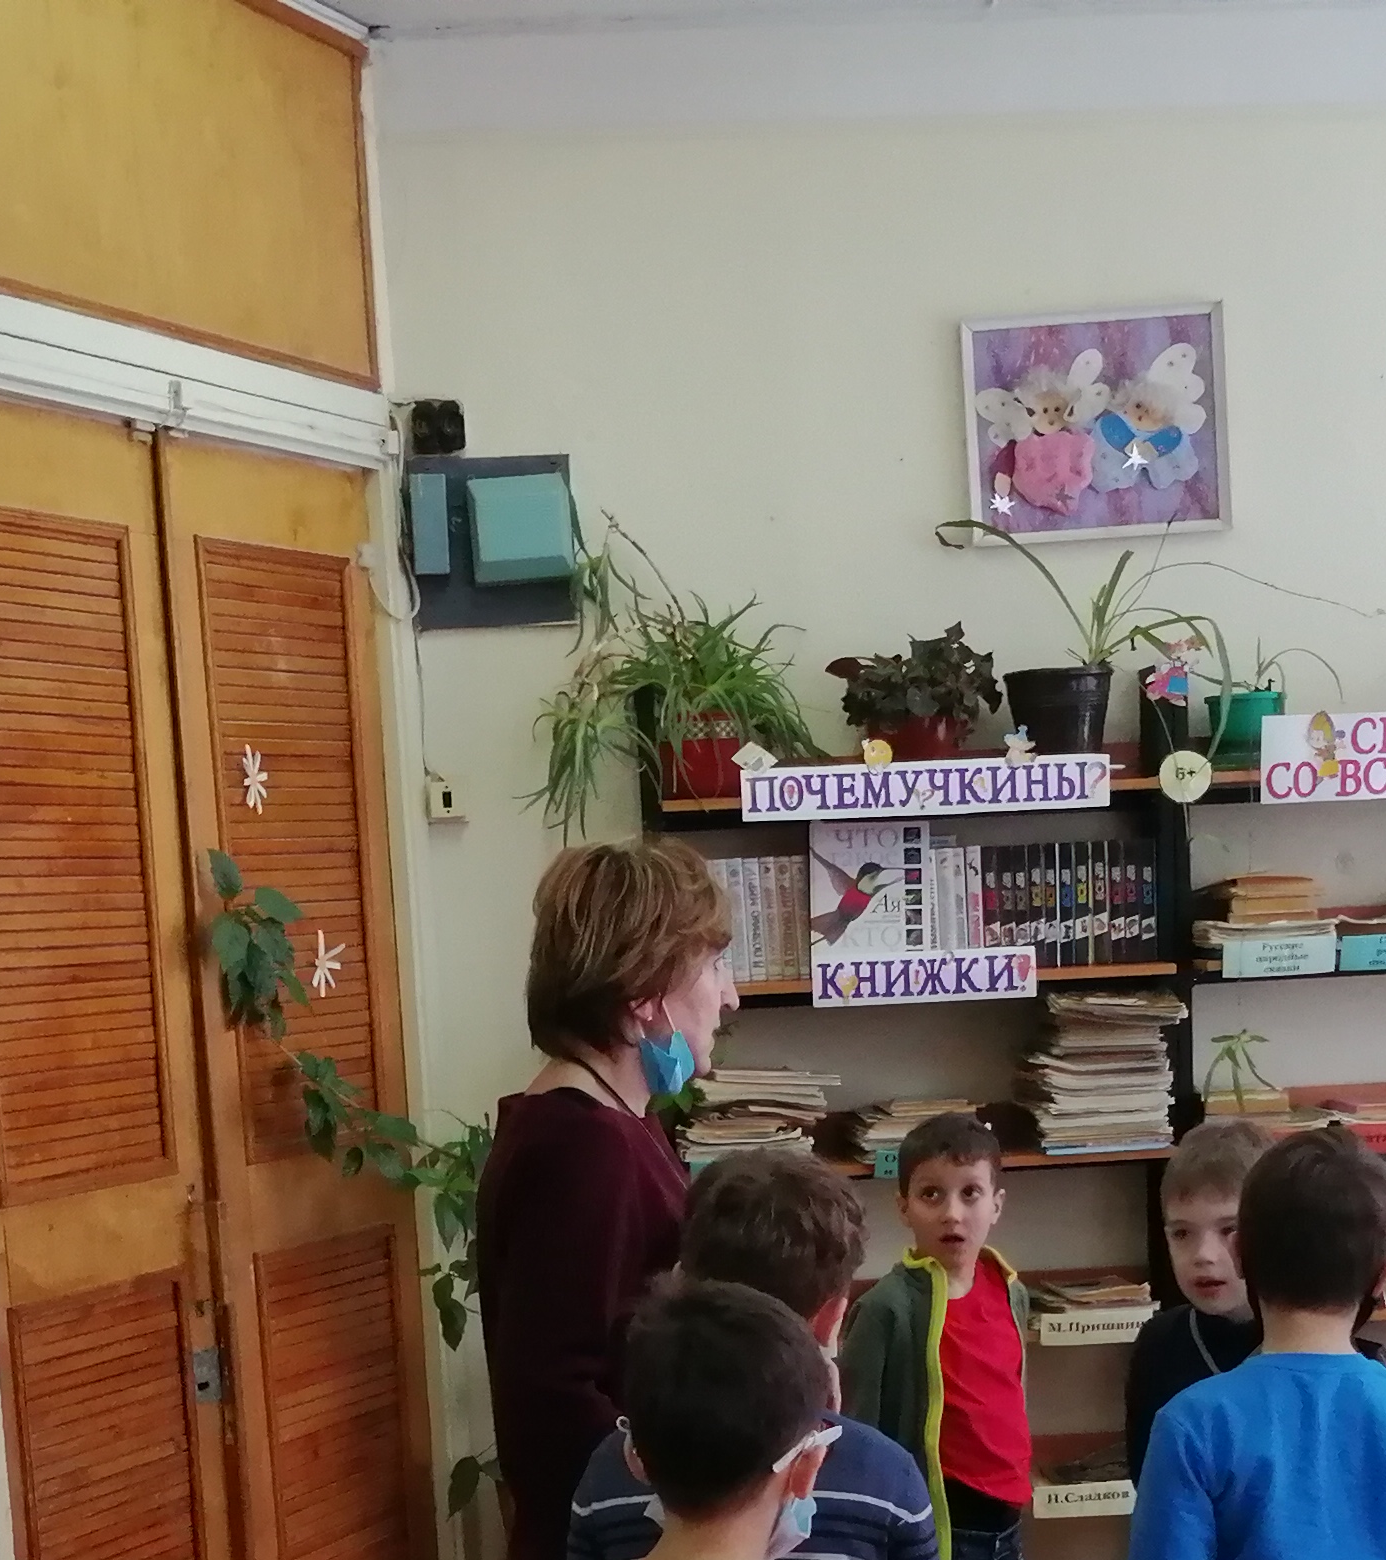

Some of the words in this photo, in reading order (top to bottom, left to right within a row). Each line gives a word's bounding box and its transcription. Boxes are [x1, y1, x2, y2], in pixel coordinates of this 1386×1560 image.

[1266, 761, 1317, 799] СО
[835, 828, 898, 849] ЧТО
[1047, 1490, 1130, 1504] Н.Сладков
